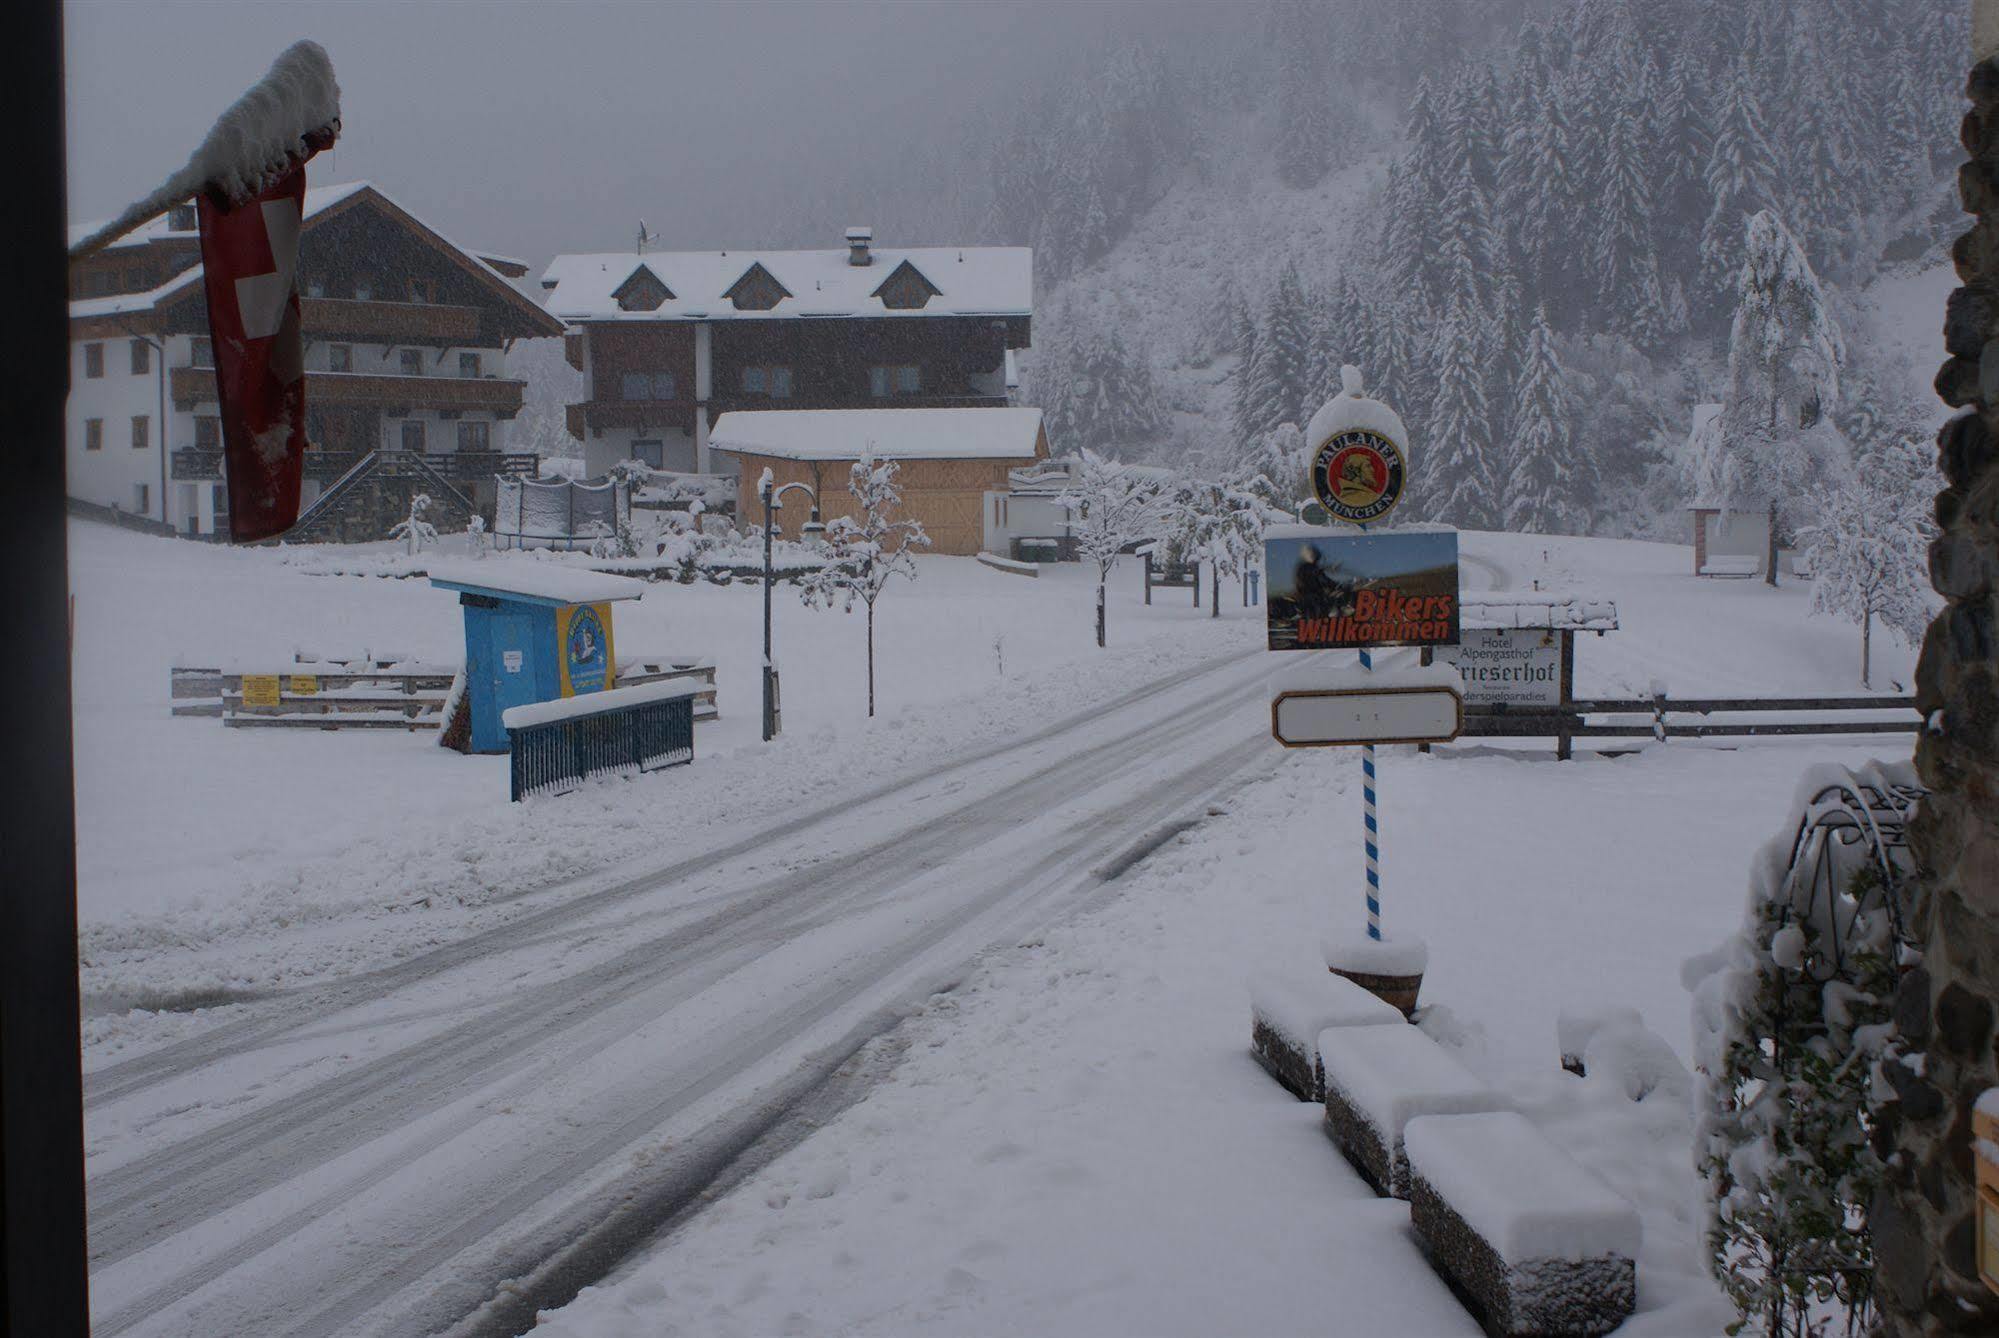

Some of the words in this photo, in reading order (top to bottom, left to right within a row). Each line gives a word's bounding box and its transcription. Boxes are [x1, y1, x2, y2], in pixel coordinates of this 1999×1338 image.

[1318, 433, 1399, 469] PAULANER
[1355, 588, 1453, 622] Bikers
[1298, 617, 1449, 643] Willkommen
[1482, 636, 1513, 648] Hotel
[1460, 648, 1534, 662] Alpengasthof
[1450, 662, 1555, 684] rieserhof
[1462, 691, 1547, 703] derspielparadies
